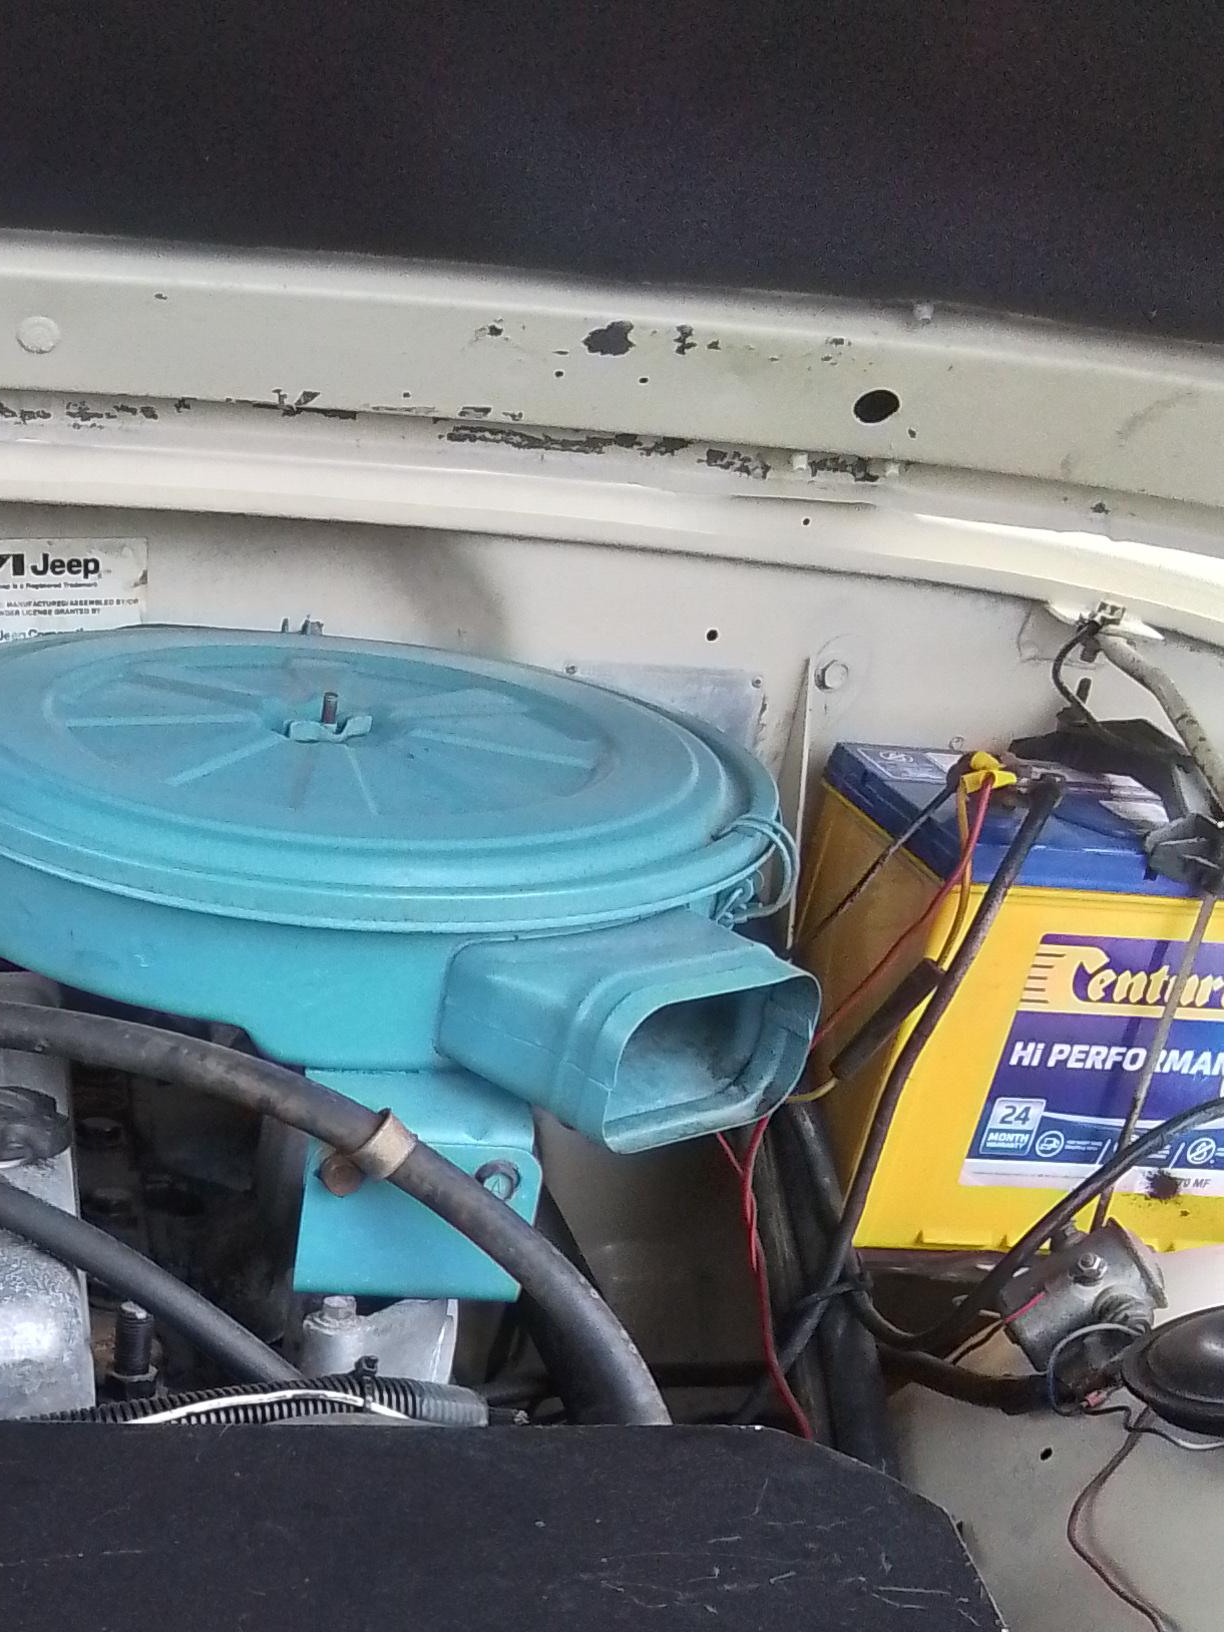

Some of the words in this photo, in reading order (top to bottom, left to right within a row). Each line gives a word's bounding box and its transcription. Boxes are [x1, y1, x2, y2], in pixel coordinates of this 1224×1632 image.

[31, 553, 100, 579] Jeep
[1021, 944, 1224, 1007] Centur
[1009, 1041, 1044, 1067] Hi
[999, 1105, 1032, 1125] 24
[987, 1132, 1030, 1144] MONTH
